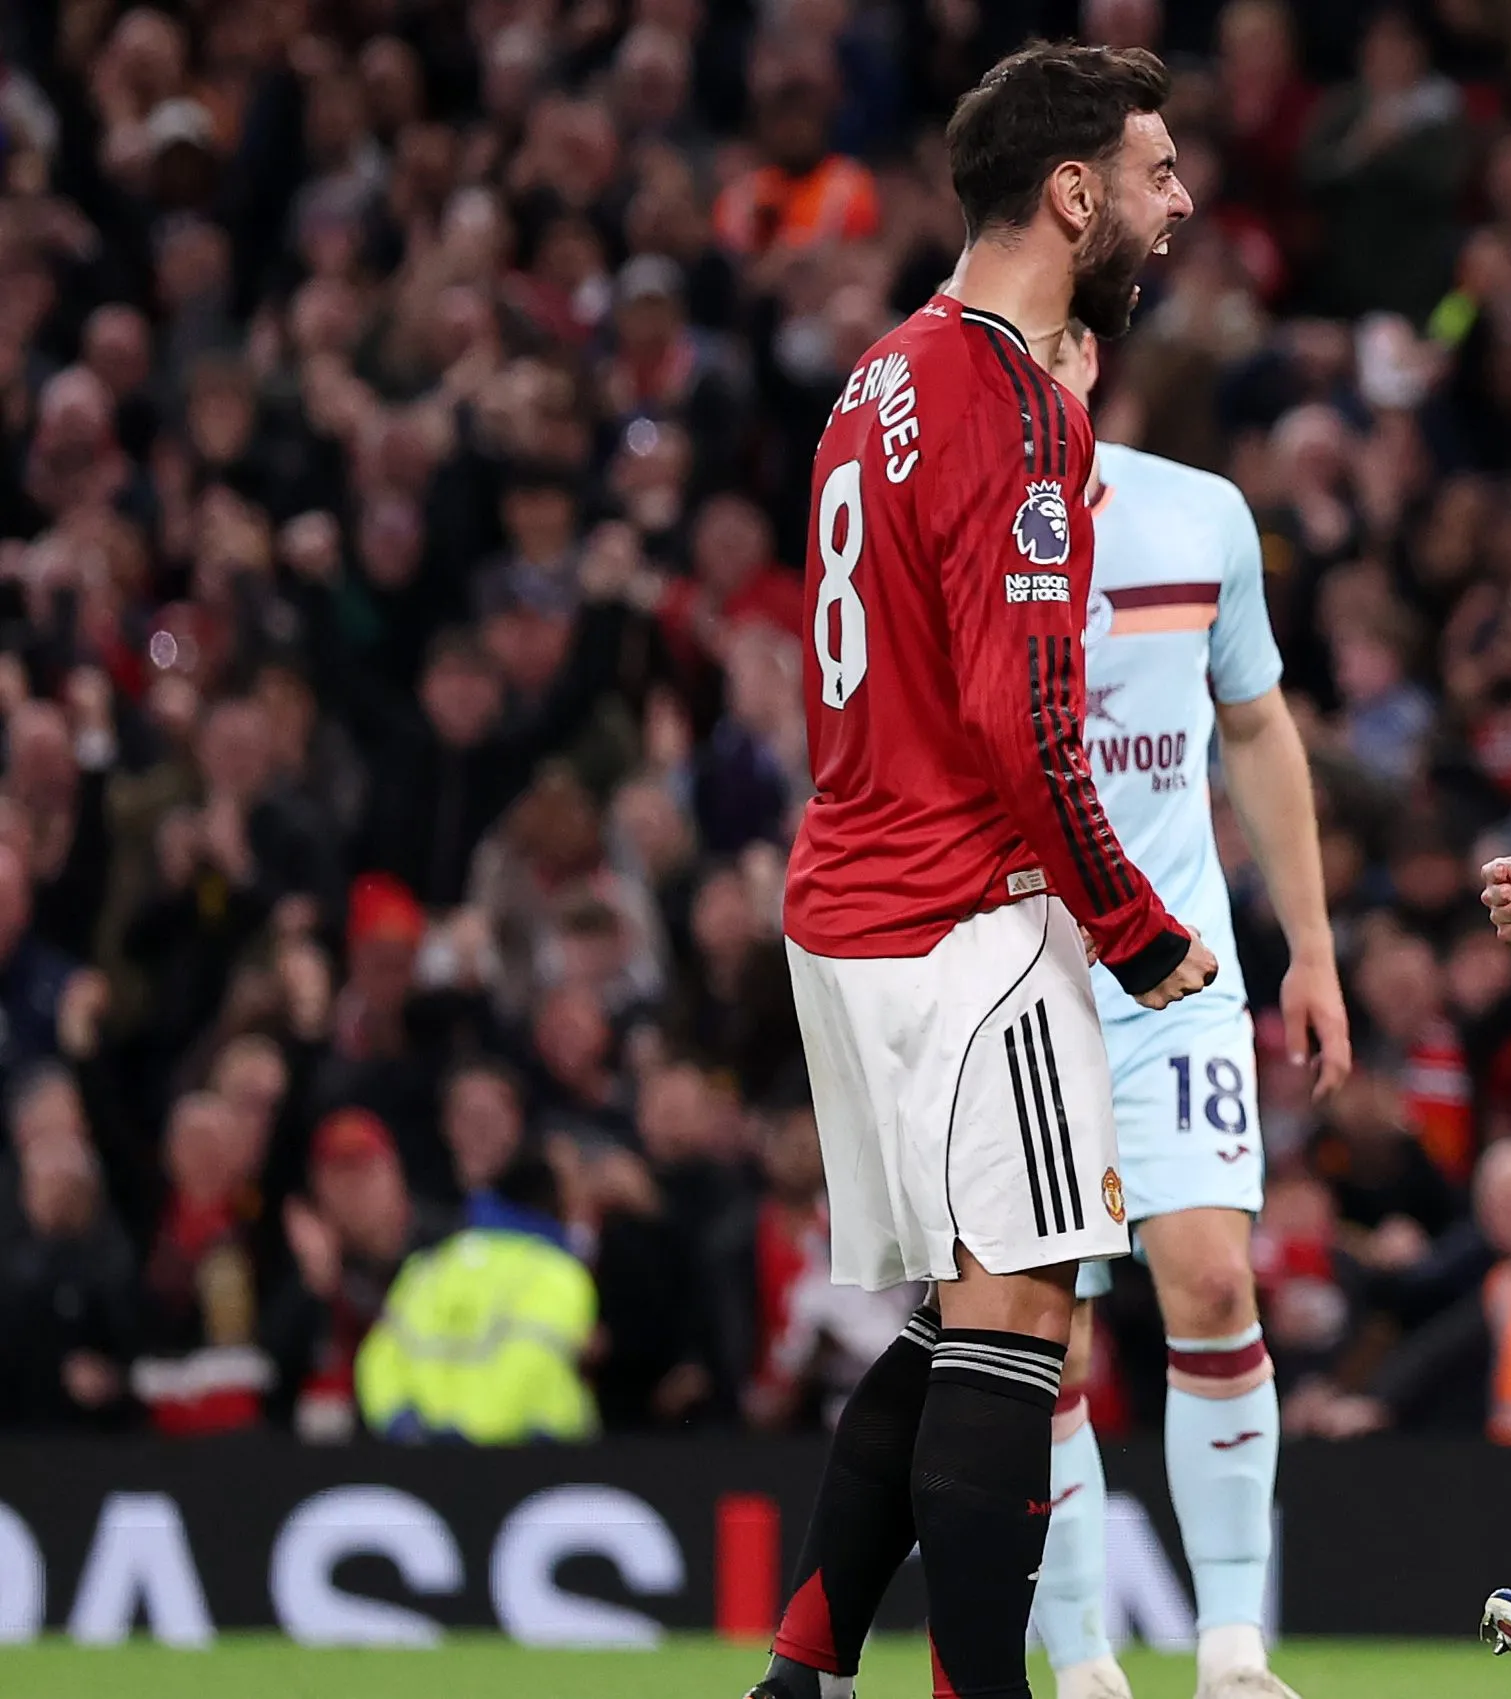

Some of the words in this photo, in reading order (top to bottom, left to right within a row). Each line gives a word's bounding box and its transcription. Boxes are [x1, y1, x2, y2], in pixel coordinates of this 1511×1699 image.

[814, 459, 868, 711] 8
[1005, 573, 1031, 589] No
[1168, 1055, 1247, 1135] 18
